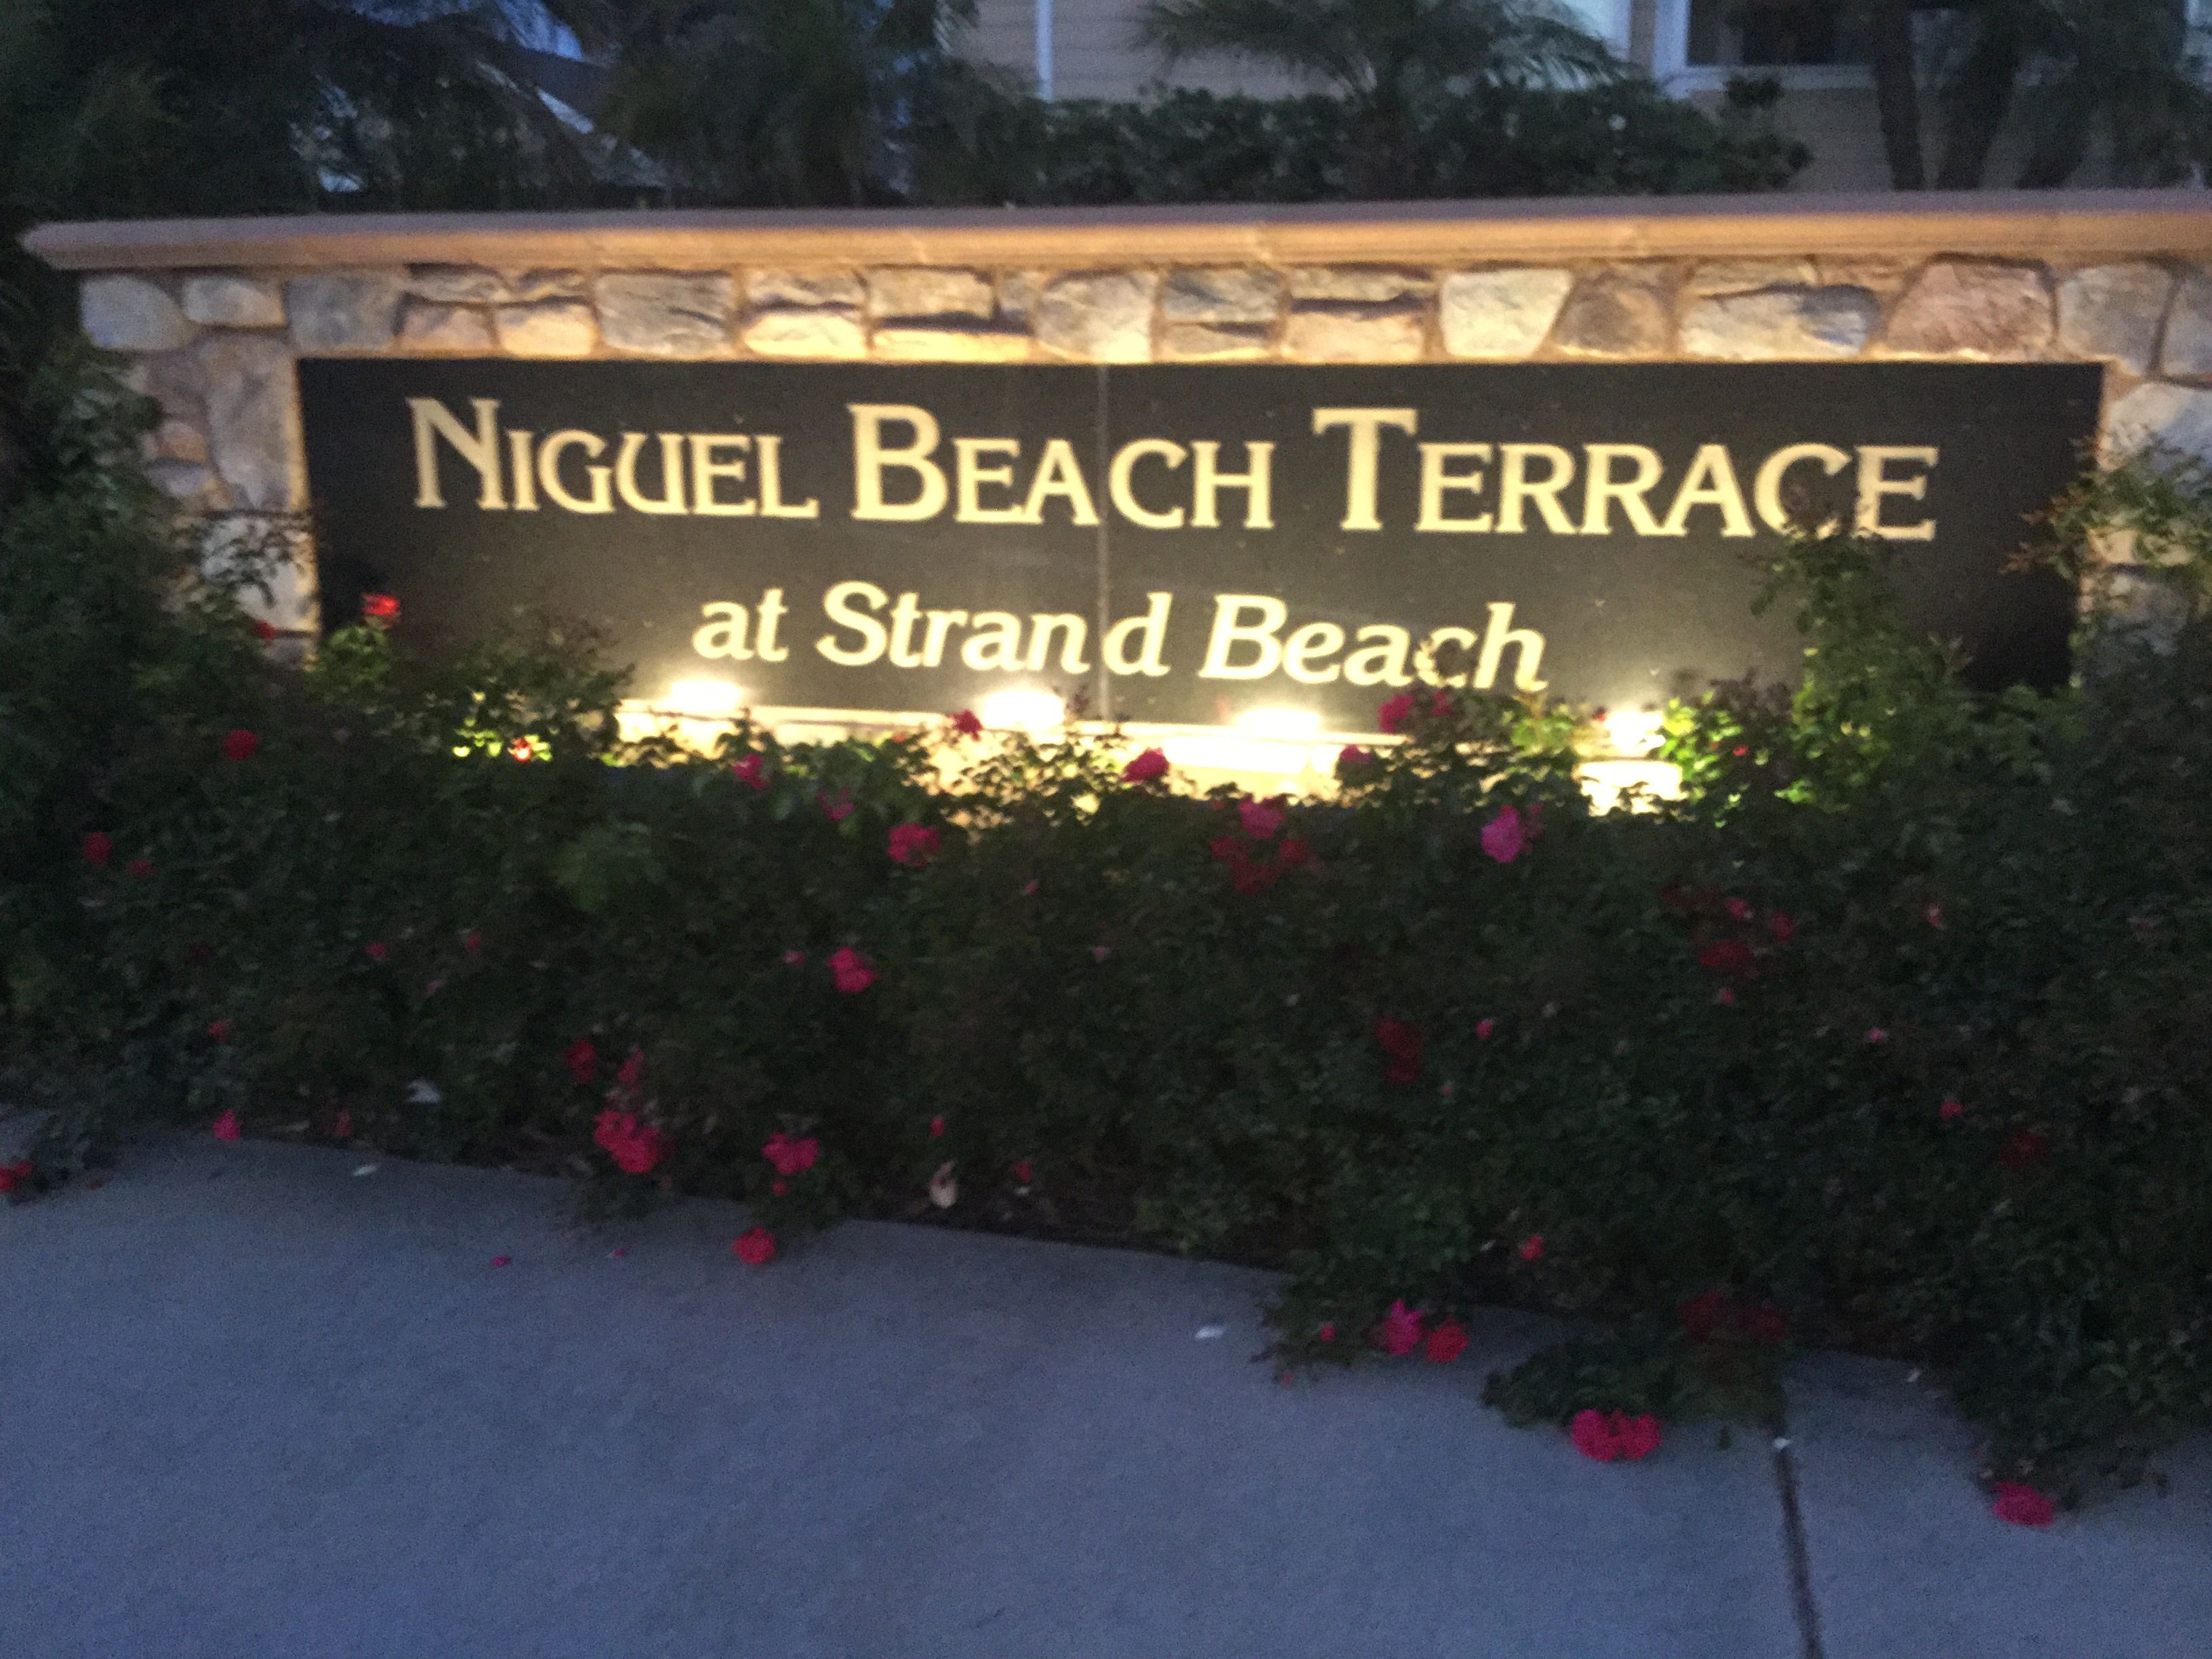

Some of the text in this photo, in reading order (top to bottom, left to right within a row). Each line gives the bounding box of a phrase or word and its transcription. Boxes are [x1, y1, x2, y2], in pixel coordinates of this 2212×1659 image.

[407, 397, 1940, 541] NIGUEL BEACH TERRACE
[692, 581, 1549, 692] at Strand Beach
